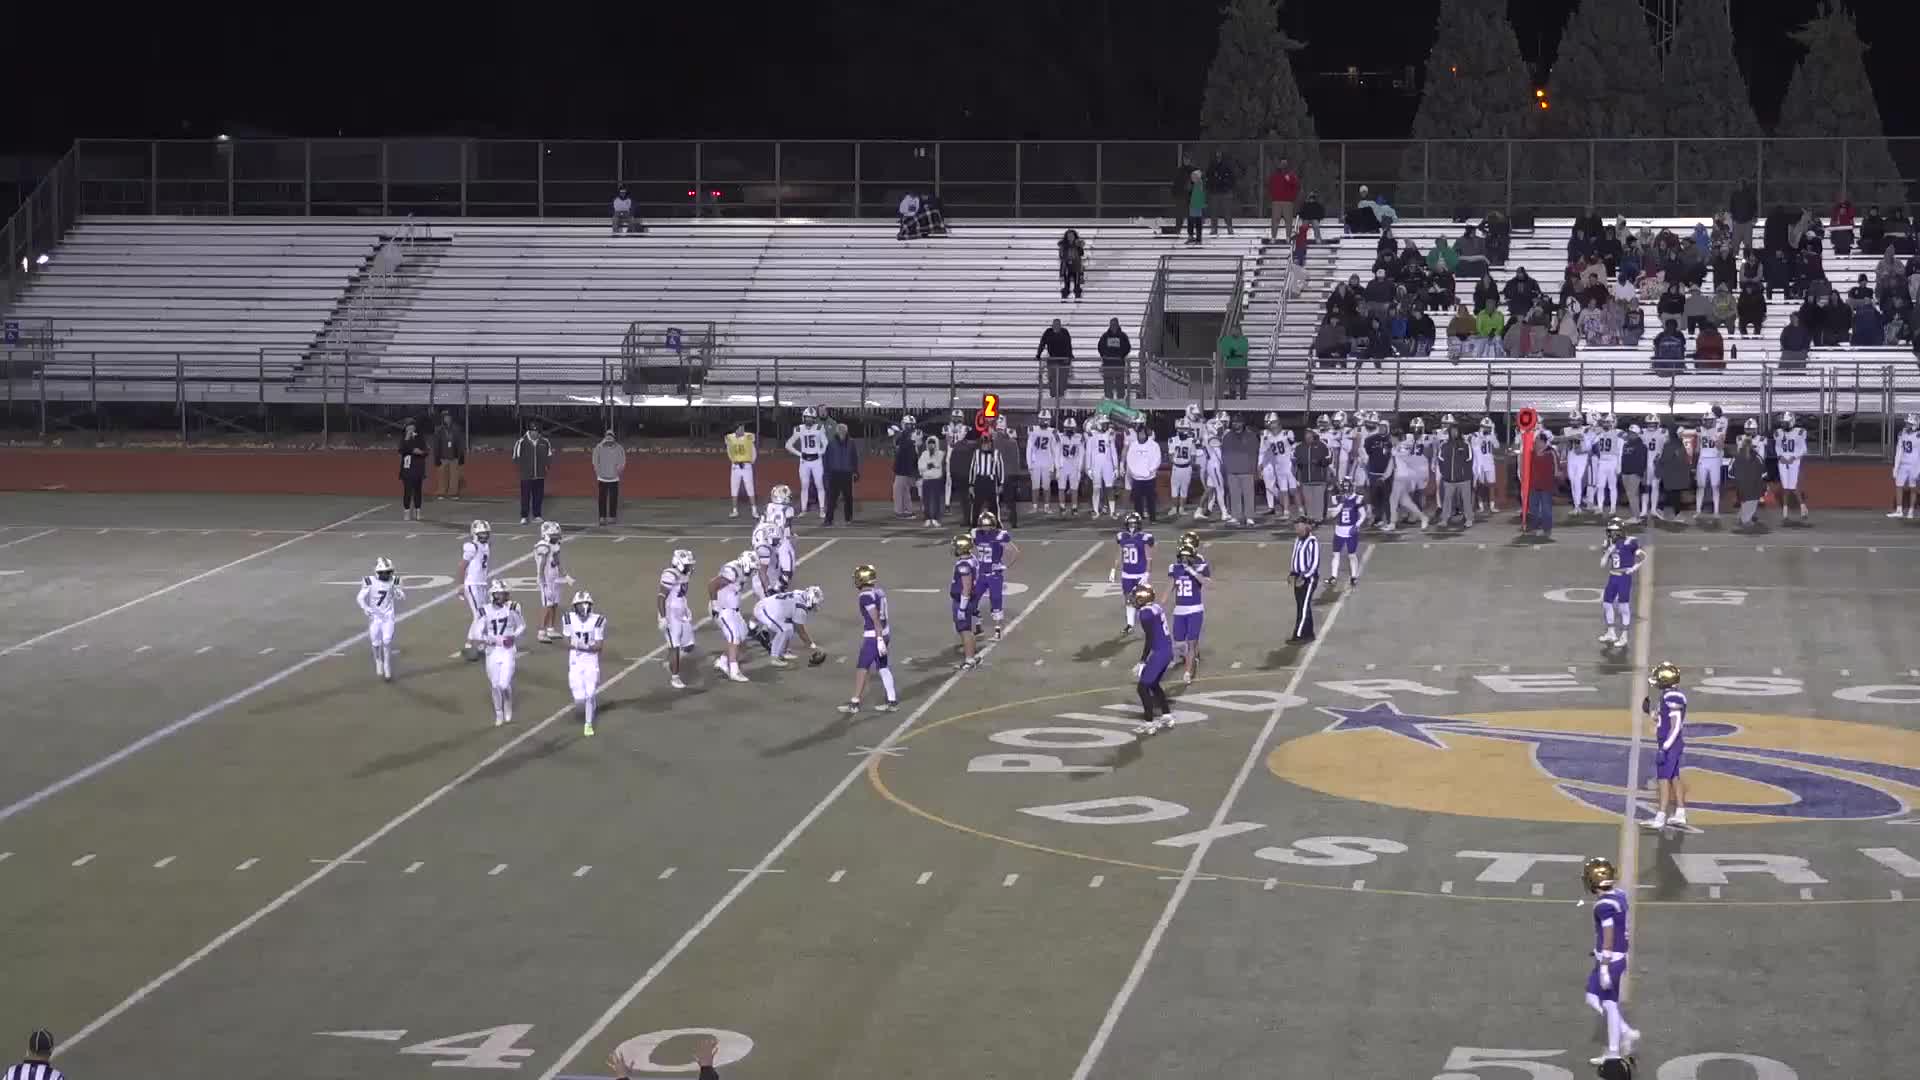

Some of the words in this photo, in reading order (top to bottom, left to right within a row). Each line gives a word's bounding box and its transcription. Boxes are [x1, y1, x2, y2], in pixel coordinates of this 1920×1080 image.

[984, 395, 996, 417] 2
[1034, 437, 1049, 450] 42
[1098, 440, 1106, 453] 5
[1122, 548, 1137, 564] 20
[1174, 580, 1193, 596] 32
[376, 590, 387, 607] 7
[490, 616, 507, 636] 17
[400, 1023, 754, 1073] 40
